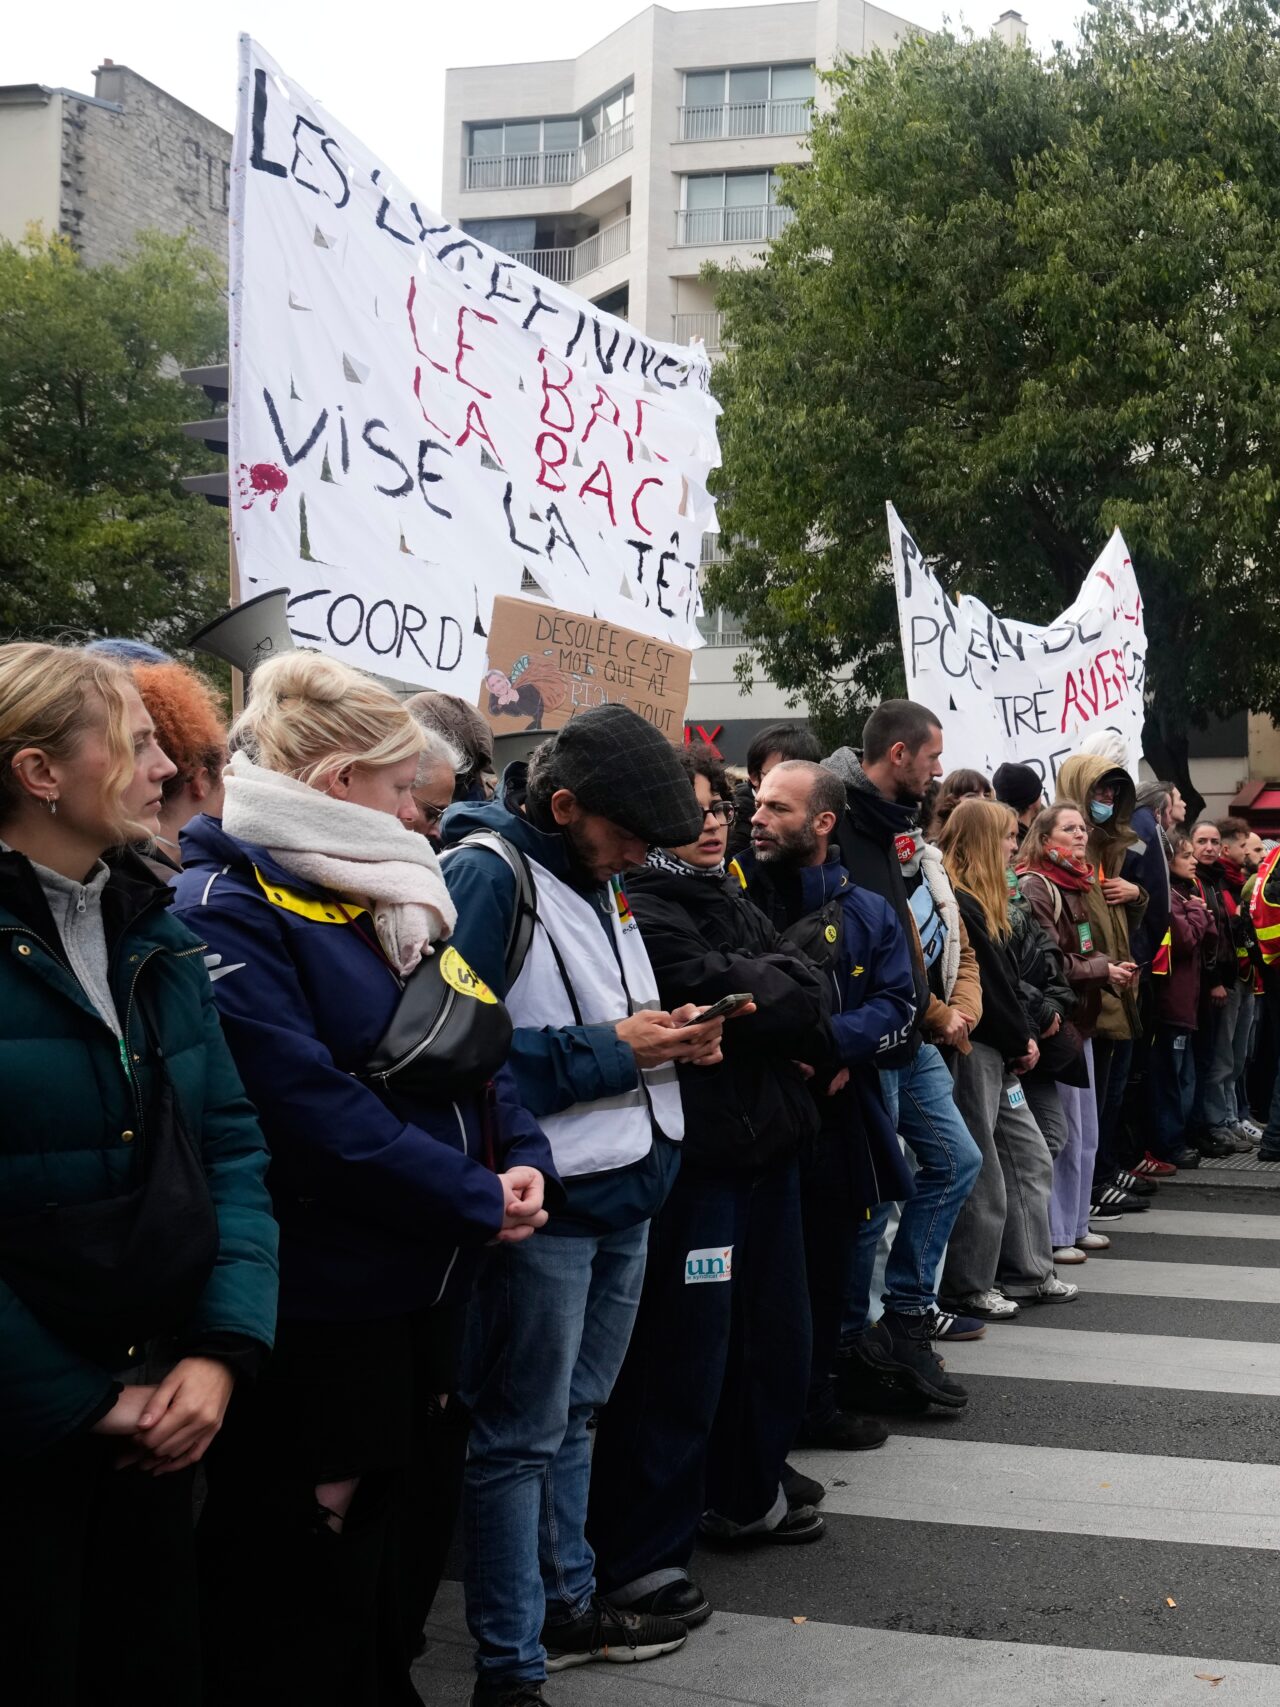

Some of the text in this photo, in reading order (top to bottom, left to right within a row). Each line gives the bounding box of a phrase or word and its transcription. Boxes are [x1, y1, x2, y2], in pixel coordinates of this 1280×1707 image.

[250, 68, 351, 208] LES
[407, 276, 498, 399] LE
[413, 366, 505, 467] LA
[503, 481, 591, 575] LA
[535, 431, 665, 536] BAC
[559, 649, 668, 697] MOI QUI AI
[626, 639, 674, 674] C'EST
[634, 700, 676, 731] TOUT
[994, 690, 1057, 738] TRE
